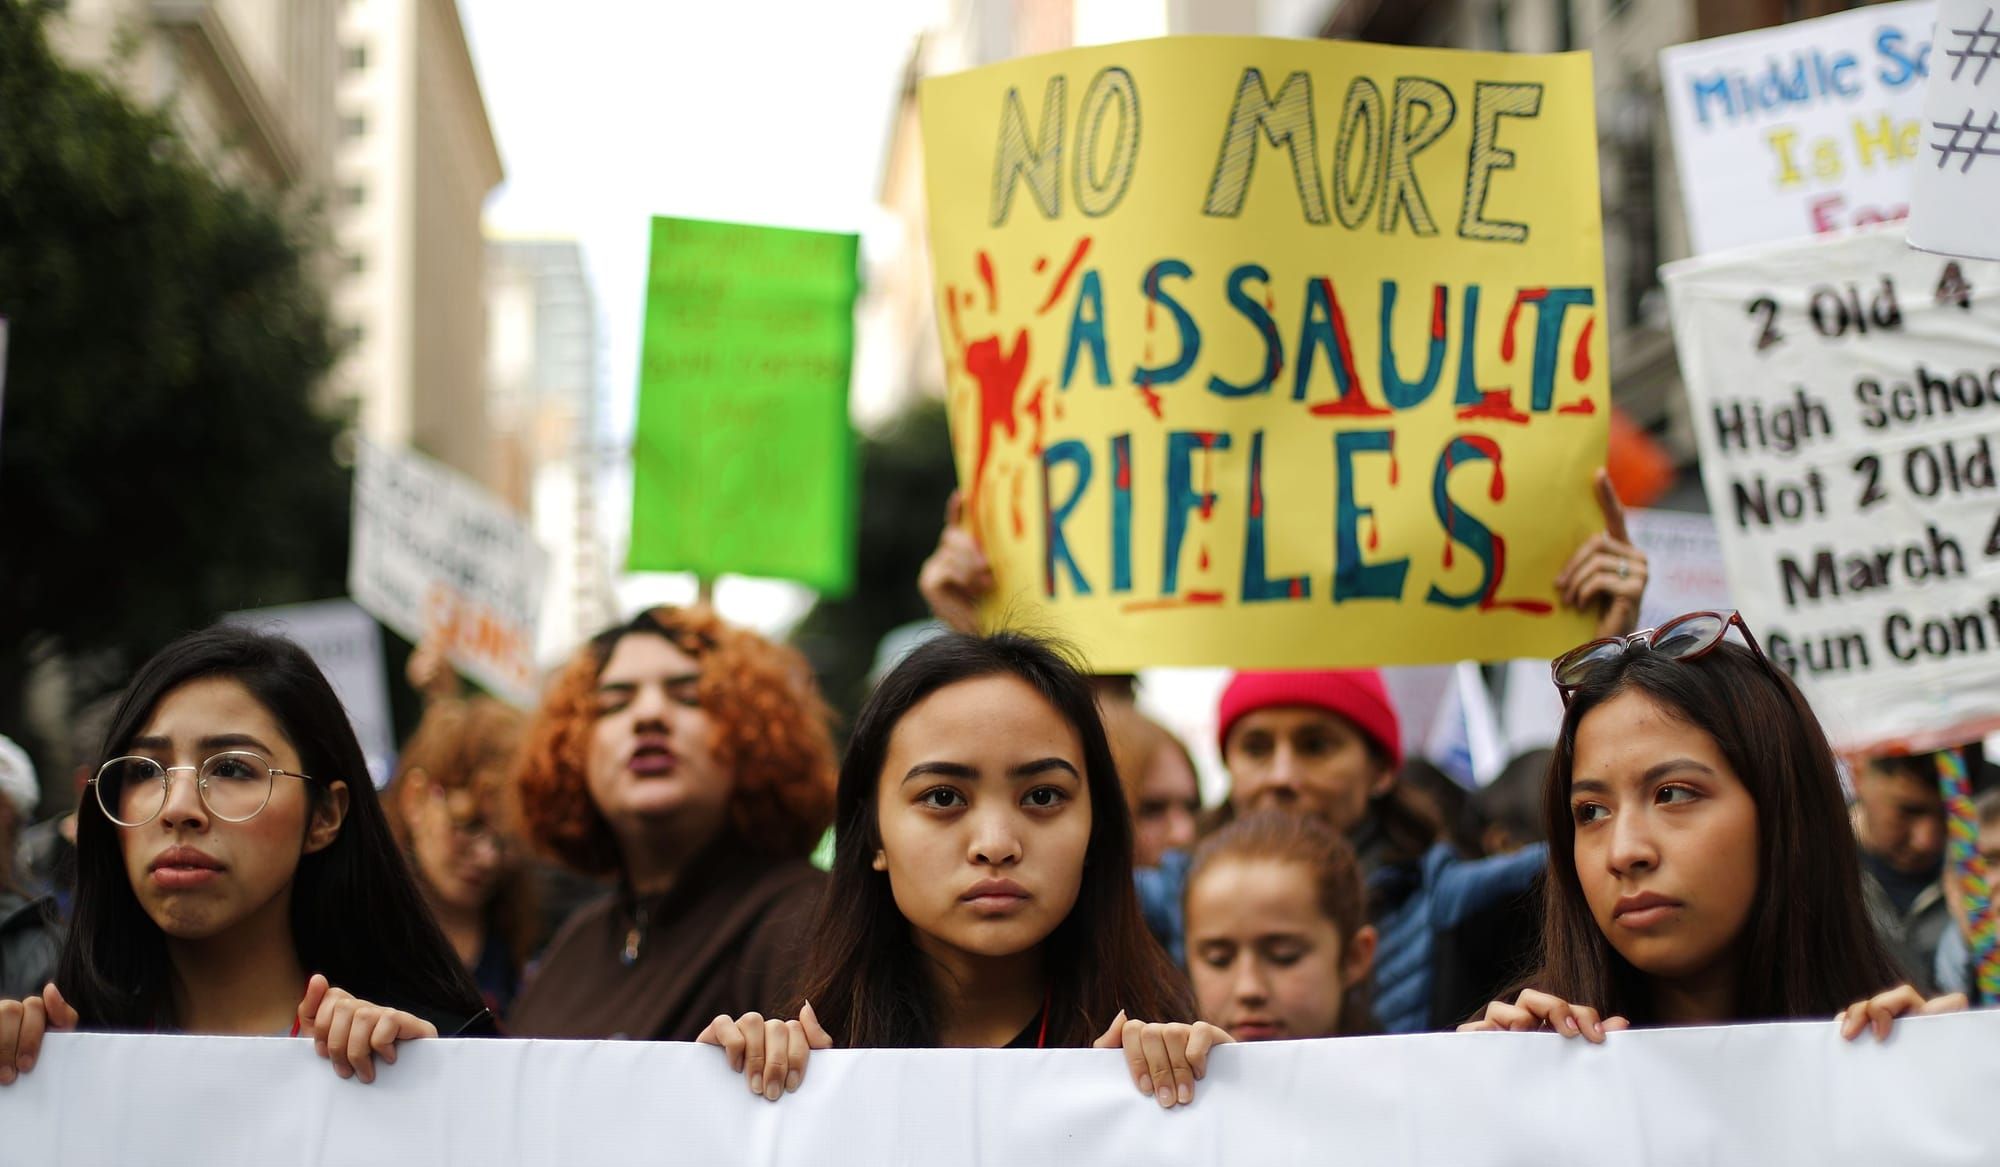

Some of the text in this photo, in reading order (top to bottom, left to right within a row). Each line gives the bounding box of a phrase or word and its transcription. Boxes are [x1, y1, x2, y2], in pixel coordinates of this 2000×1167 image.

[1693, 24, 1937, 124] Middle Sc
[990, 66, 1544, 243] NO MORE
[1768, 128, 1843, 184] Is
[1060, 258, 1595, 418] ASSAULT
[1747, 260, 1972, 351] 2 Old 4
[1712, 388, 1832, 454] High
[1038, 428, 1510, 610] RIFLES
[1732, 438, 1995, 529] Not 2 Old
[1779, 524, 1965, 605] March
[1767, 632, 1869, 680] Gun
